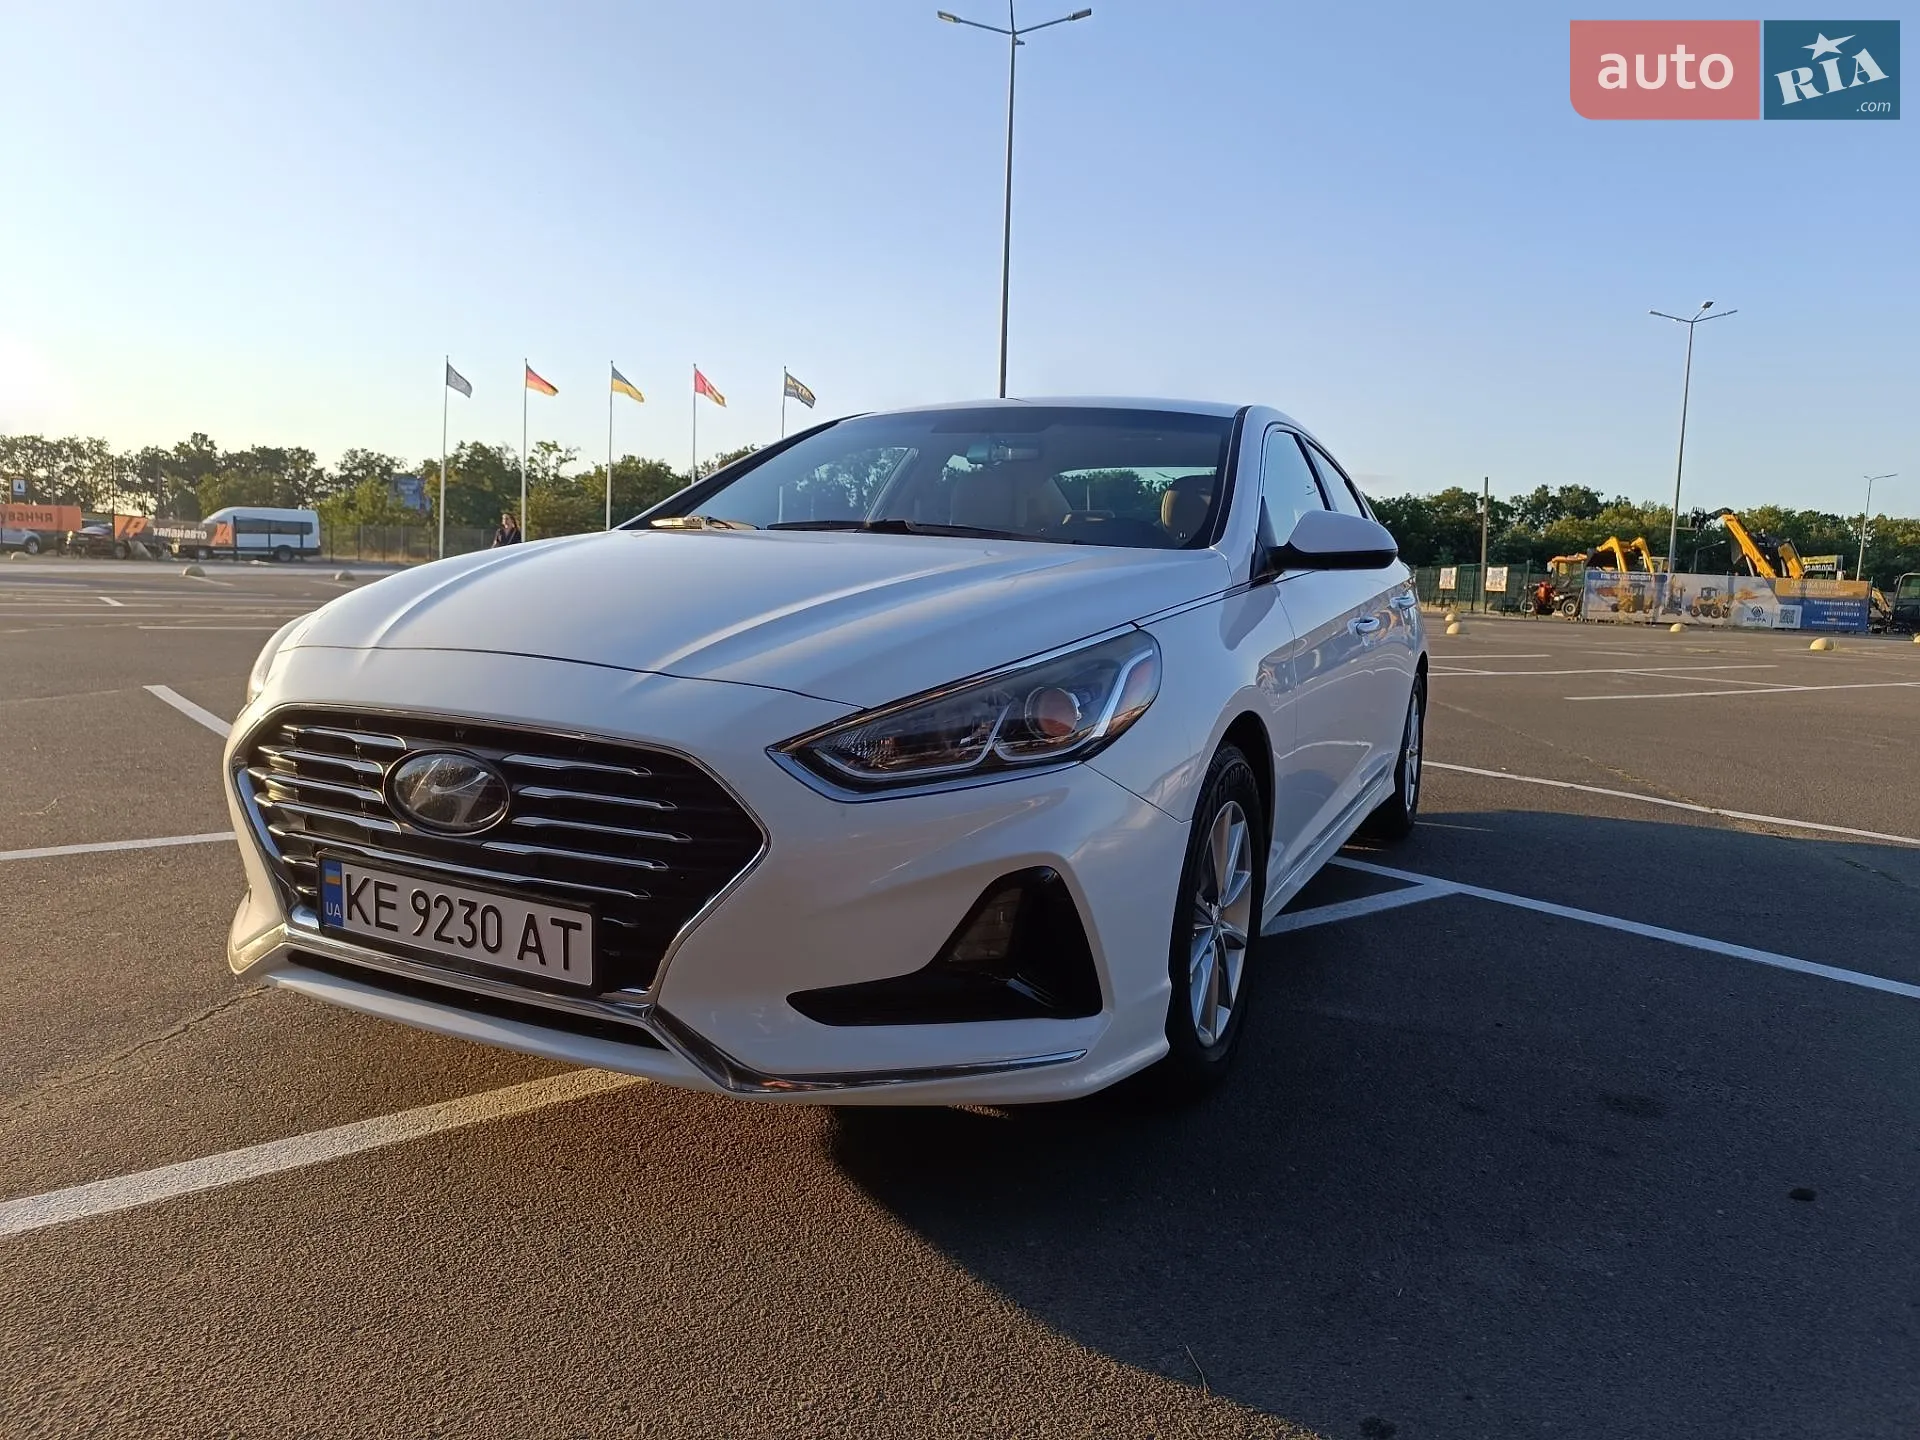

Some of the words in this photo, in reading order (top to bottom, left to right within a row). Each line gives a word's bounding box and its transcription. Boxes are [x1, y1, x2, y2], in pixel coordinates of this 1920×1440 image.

[325, 901, 342, 918] UA
[345, 874, 399, 932] KE
[410, 888, 503, 954] 9230
[517, 913, 583, 970] AT
